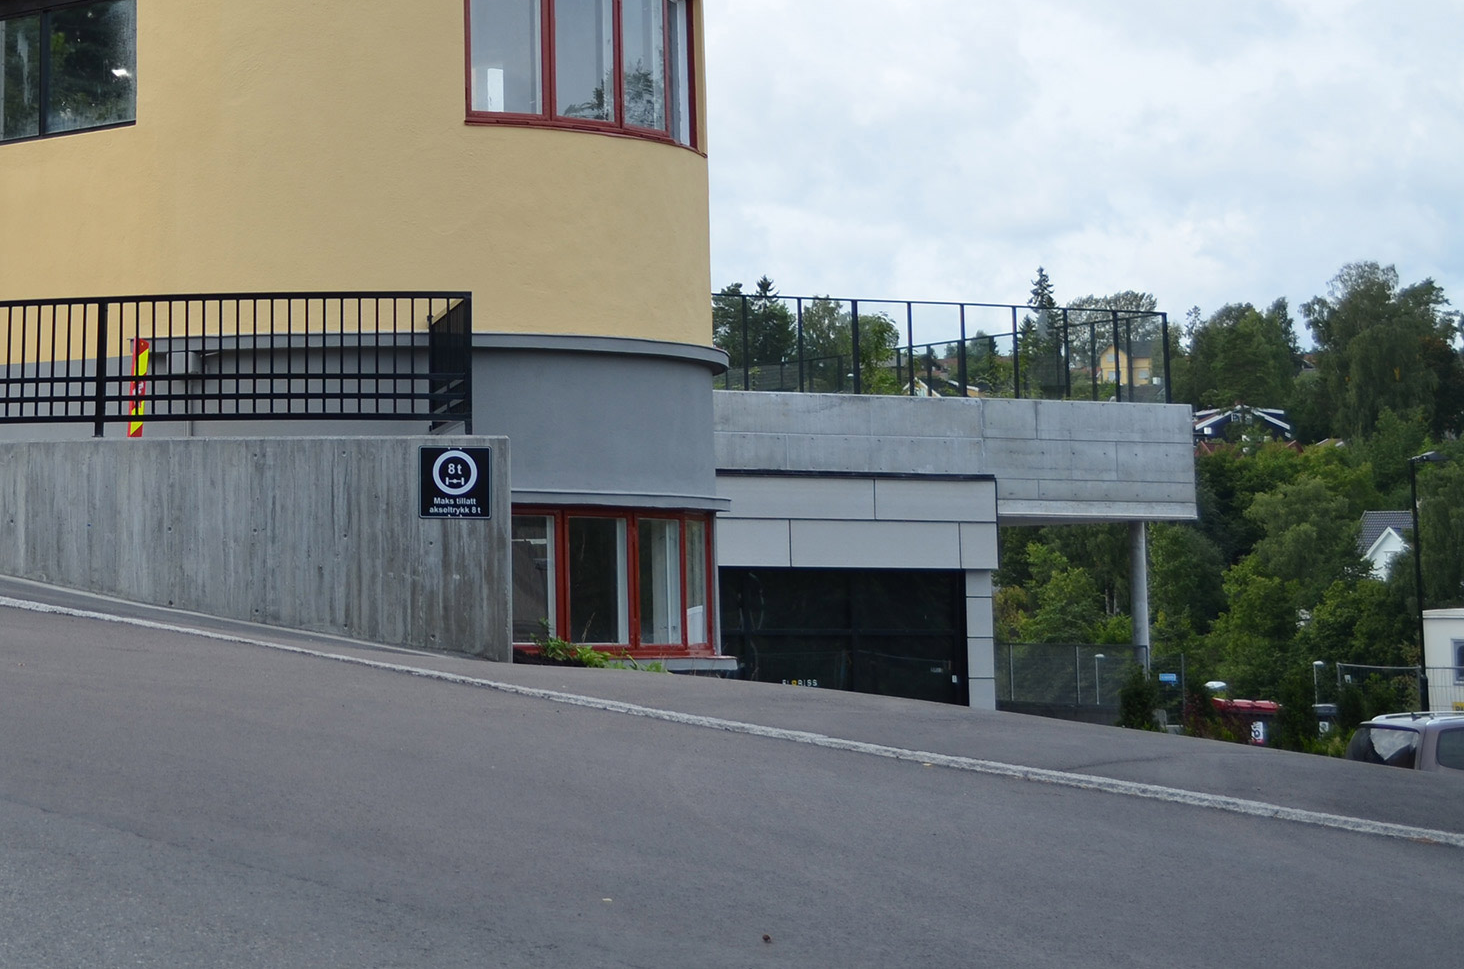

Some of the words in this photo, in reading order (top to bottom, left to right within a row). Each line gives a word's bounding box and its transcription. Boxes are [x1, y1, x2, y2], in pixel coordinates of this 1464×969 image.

[448, 463, 456, 475] 8
[457, 464, 462, 475] t
[433, 497, 454, 505] Maks
[456, 497, 477, 505] tillatt
[429, 506, 470, 515] akseltrykk
[471, 506, 477, 514] 8
[477, 506, 482, 514] t
